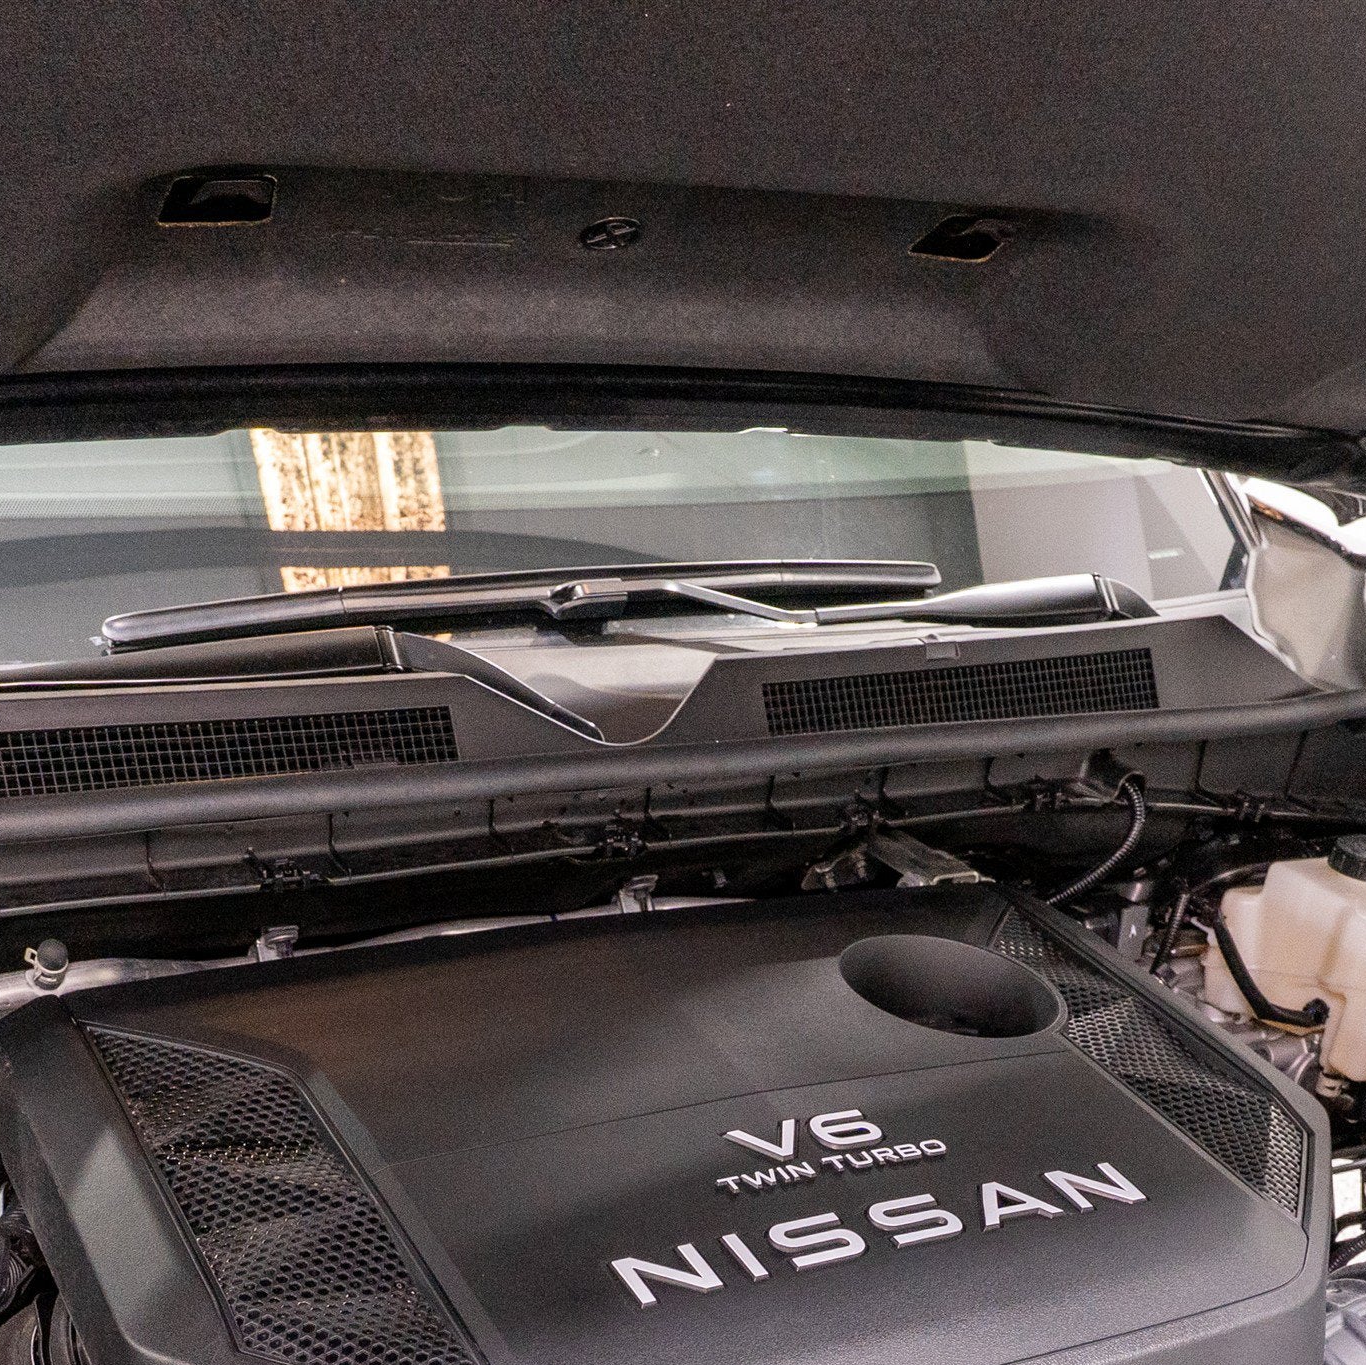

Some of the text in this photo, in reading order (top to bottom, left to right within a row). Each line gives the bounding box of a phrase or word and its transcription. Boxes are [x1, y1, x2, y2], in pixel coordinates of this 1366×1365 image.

[724, 1107, 884, 1162] V6
[716, 1138, 947, 1194] TWIN TURBO
[611, 1161, 1149, 1309] NISSAN
